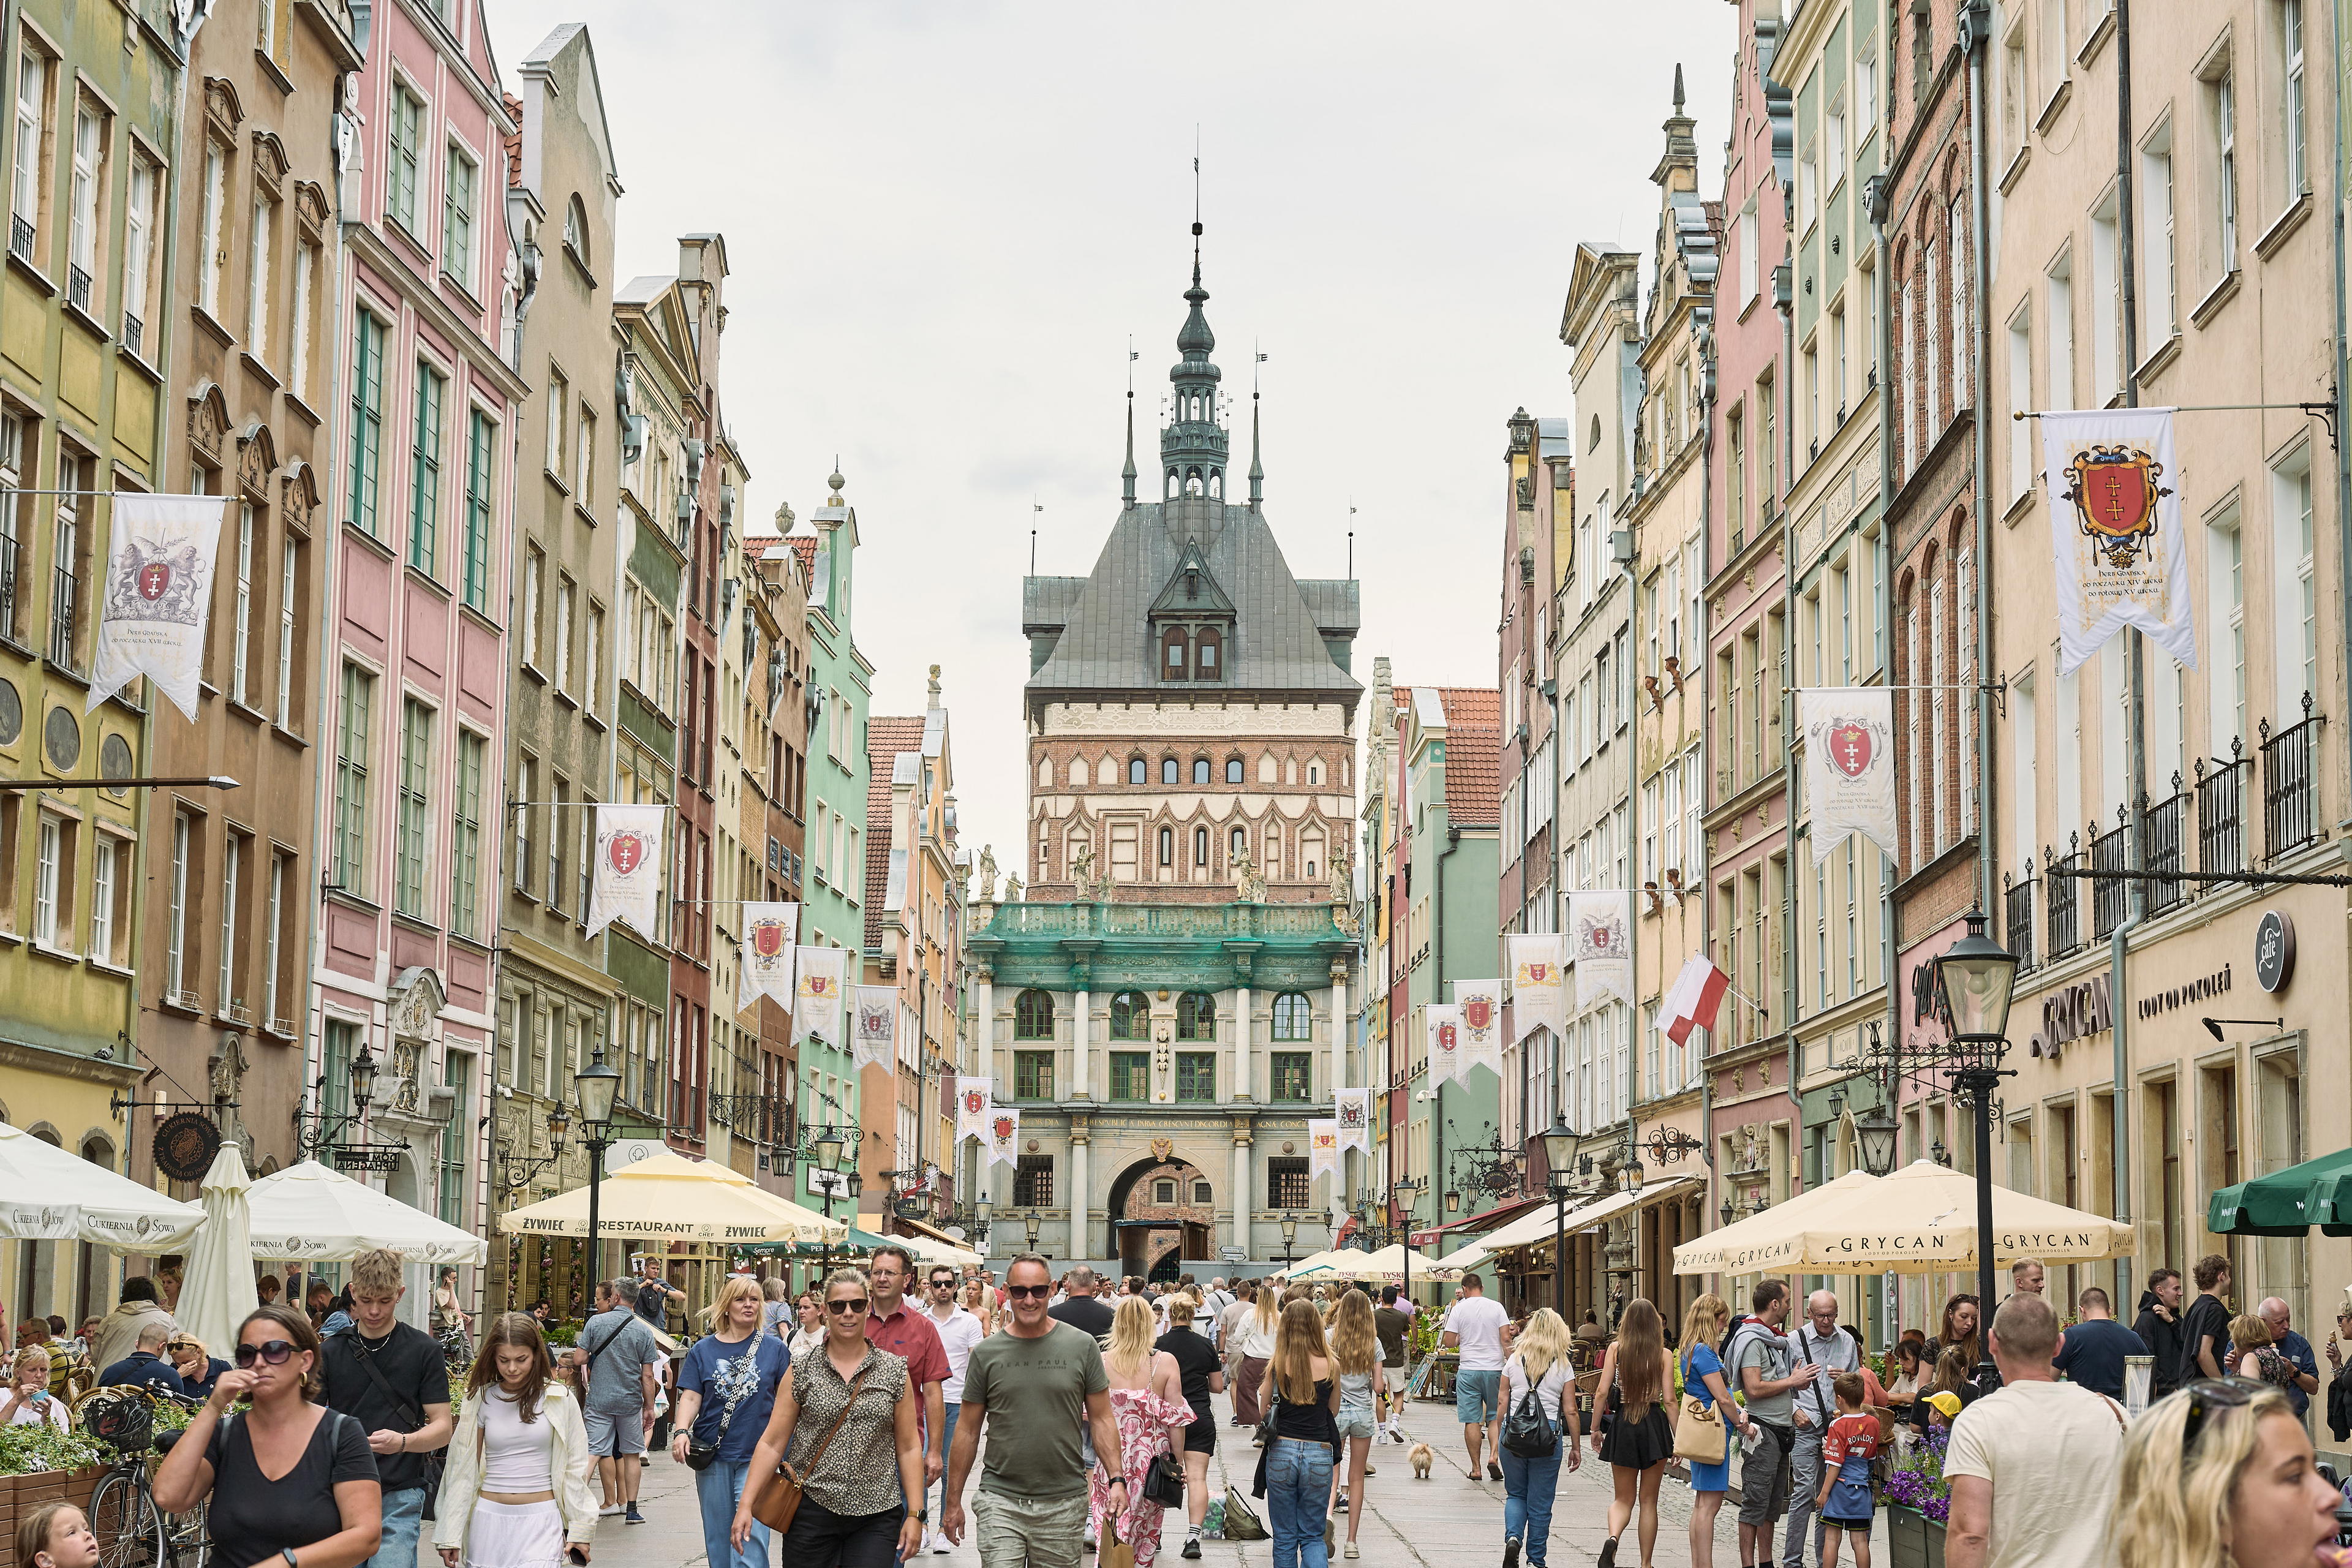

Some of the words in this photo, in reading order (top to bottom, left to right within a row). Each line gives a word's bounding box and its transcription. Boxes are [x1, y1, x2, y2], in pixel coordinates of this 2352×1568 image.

[2138, 993, 2163, 1020] LODY
[2166, 989, 2179, 1009] OD
[2182, 963, 2231, 1005] POKOLEŃ
[2030, 970, 2113, 1058] GRYCAN
[162, 1117, 198, 1137] CUKIERNIA
[200, 1122, 214, 1137] SOWA
[195, 1165, 207, 1175] 1946
[88, 1215, 134, 1231] CUKIERNIA
[153, 1219, 176, 1233] SOWA
[522, 1217, 565, 1231] ŻYWIEC
[598, 1220, 694, 1233] RESTAURANT
[725, 1225, 766, 1237] ŻYWIEC
[304, 1240, 327, 1250] SOWA
[1826, 1235, 1944, 1253] GRYCAN
[1994, 1234, 2089, 1249] GRYCAN
[439, 1246, 456, 1254] SOWA
[1732, 1242, 1791, 1267] GRYCAN
[1677, 1251, 1724, 1267] GRYCAN
